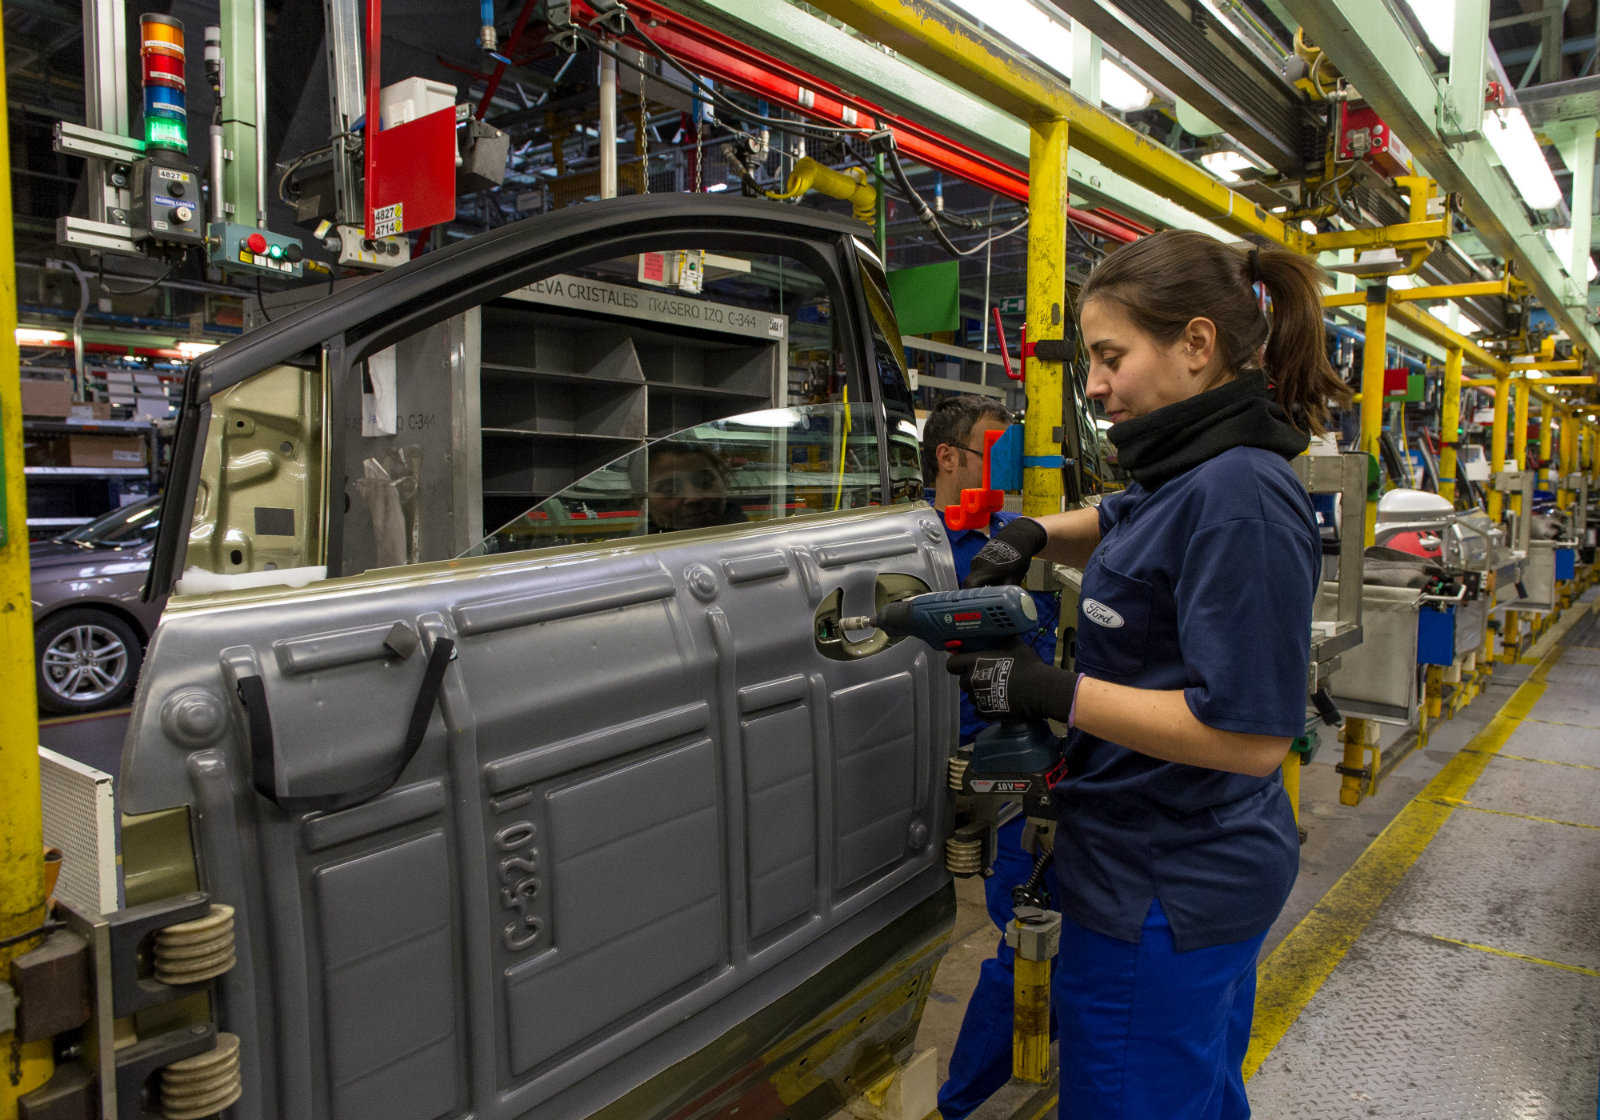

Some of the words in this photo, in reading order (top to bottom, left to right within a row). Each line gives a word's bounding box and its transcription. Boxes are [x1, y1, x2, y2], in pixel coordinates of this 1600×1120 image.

[160, 169, 181, 179] 4827
[376, 206, 394, 220] 4827
[376, 222, 394, 236] 4714
[520, 279, 564, 297] LEVA
[567, 283, 639, 309] CRISTALES
[648, 297, 700, 319] TRASERO
[703, 306, 724, 324] IZQ
